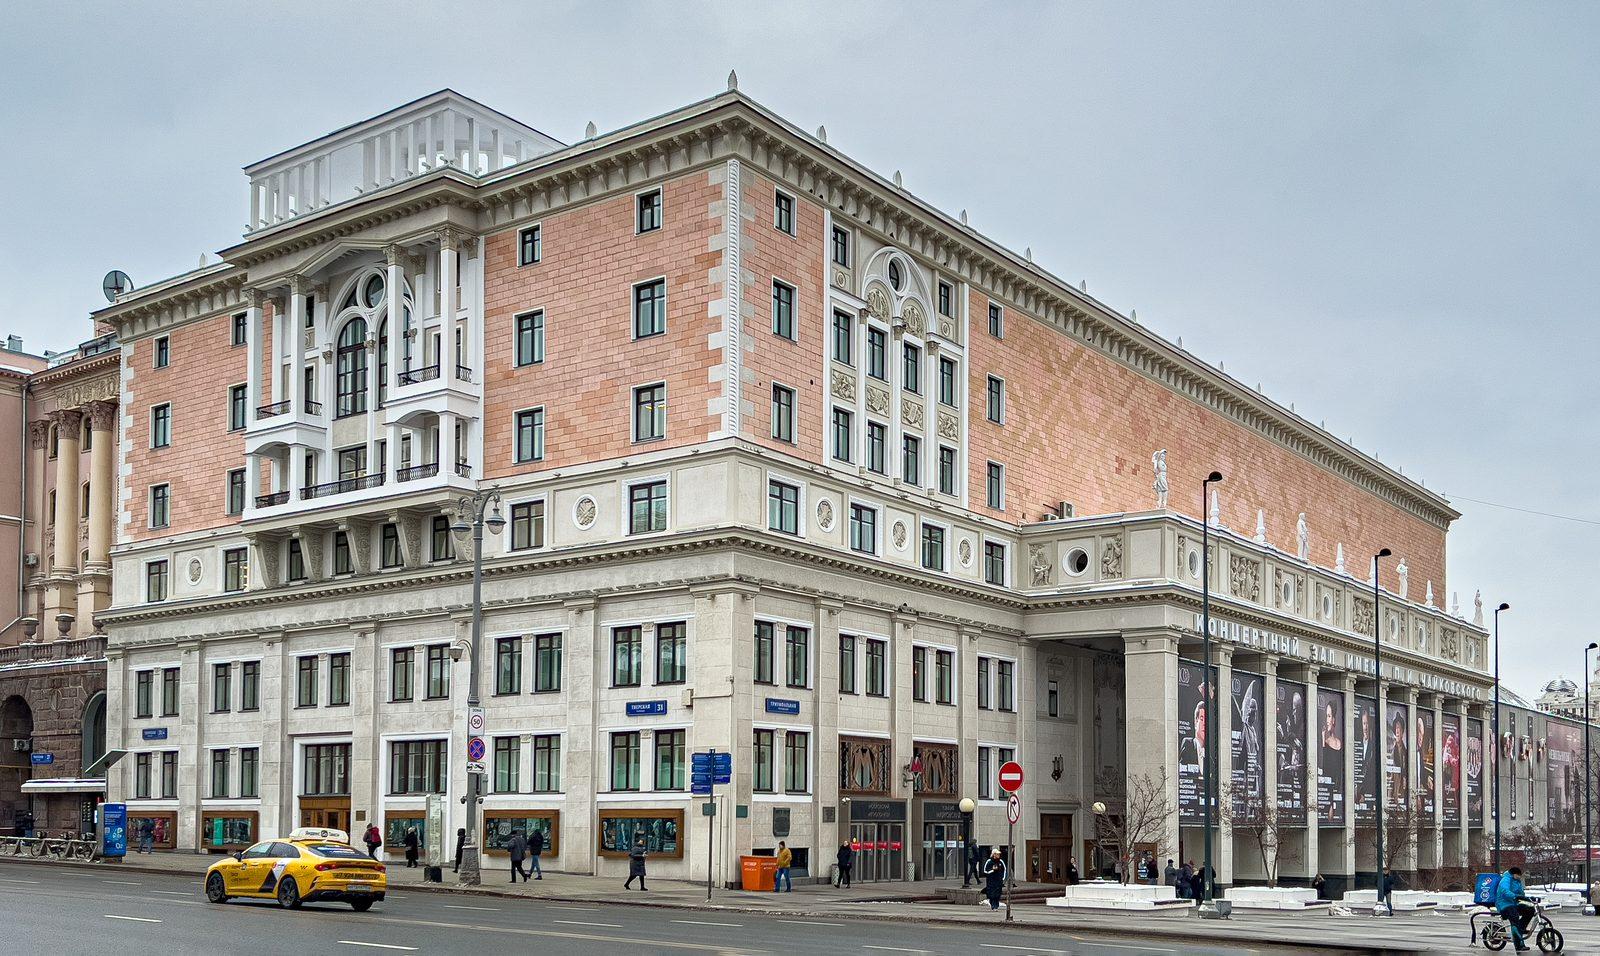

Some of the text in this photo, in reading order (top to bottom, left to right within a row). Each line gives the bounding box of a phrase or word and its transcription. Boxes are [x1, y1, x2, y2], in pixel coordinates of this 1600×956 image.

[1194, 613, 1299, 657] КОНЦЕРТНЫЙ
[1310, 643, 1335, 665] ЗАЛ
[1346, 652, 1384, 677] ИМЕНИ
[1420, 673, 1481, 700] ЧАЙКОВСКОГО
